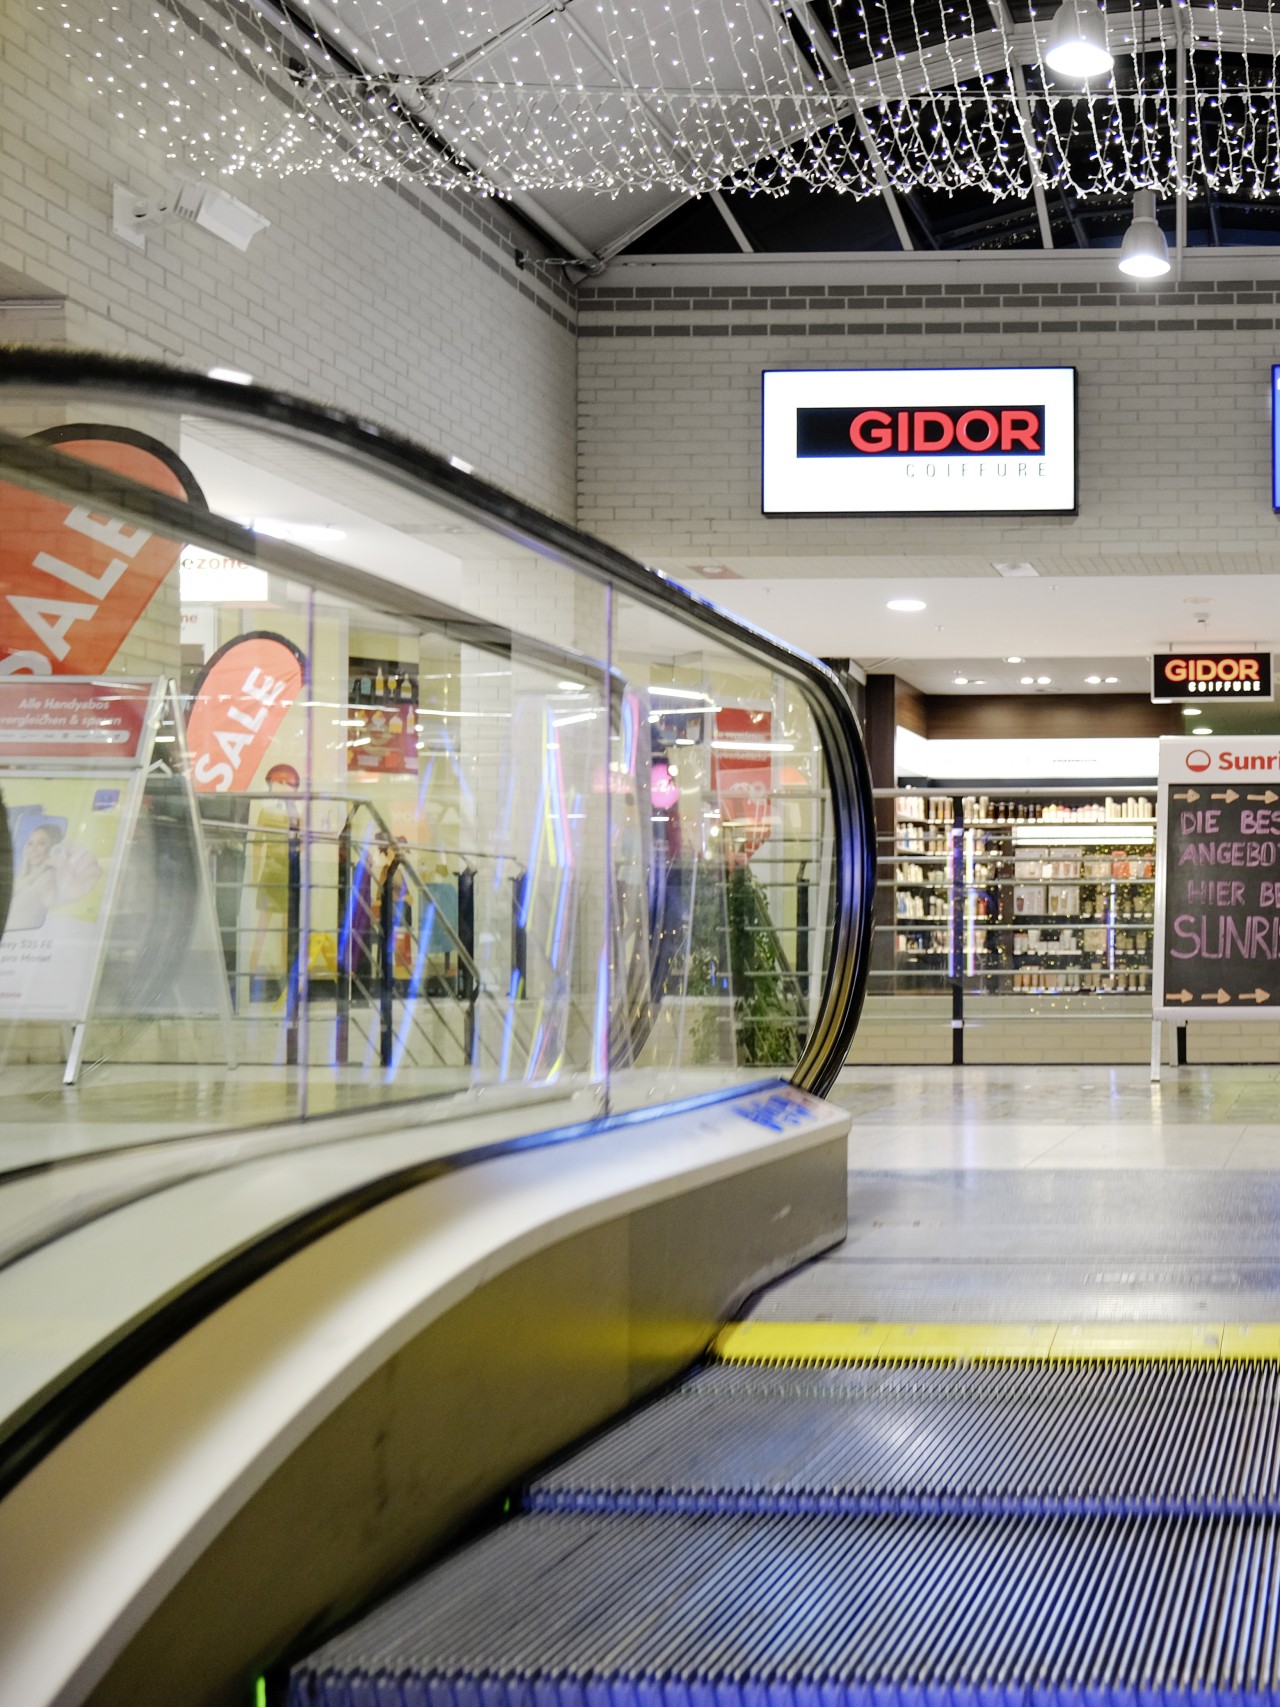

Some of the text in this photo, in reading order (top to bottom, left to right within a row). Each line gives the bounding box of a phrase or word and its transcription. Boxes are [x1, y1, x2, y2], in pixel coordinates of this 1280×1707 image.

[849, 409, 1041, 453] GIDOR
[905, 462, 1046, 478] COIFFURE
[1164, 658, 1260, 682] GIDOR
[1187, 681, 1261, 693] COIFFURE
[18, 697, 110, 713] Alle Handyabos
[194, 665, 287, 792] SALE
[1180, 810, 1221, 836] DIE
[1186, 880, 1245, 907] HIER
